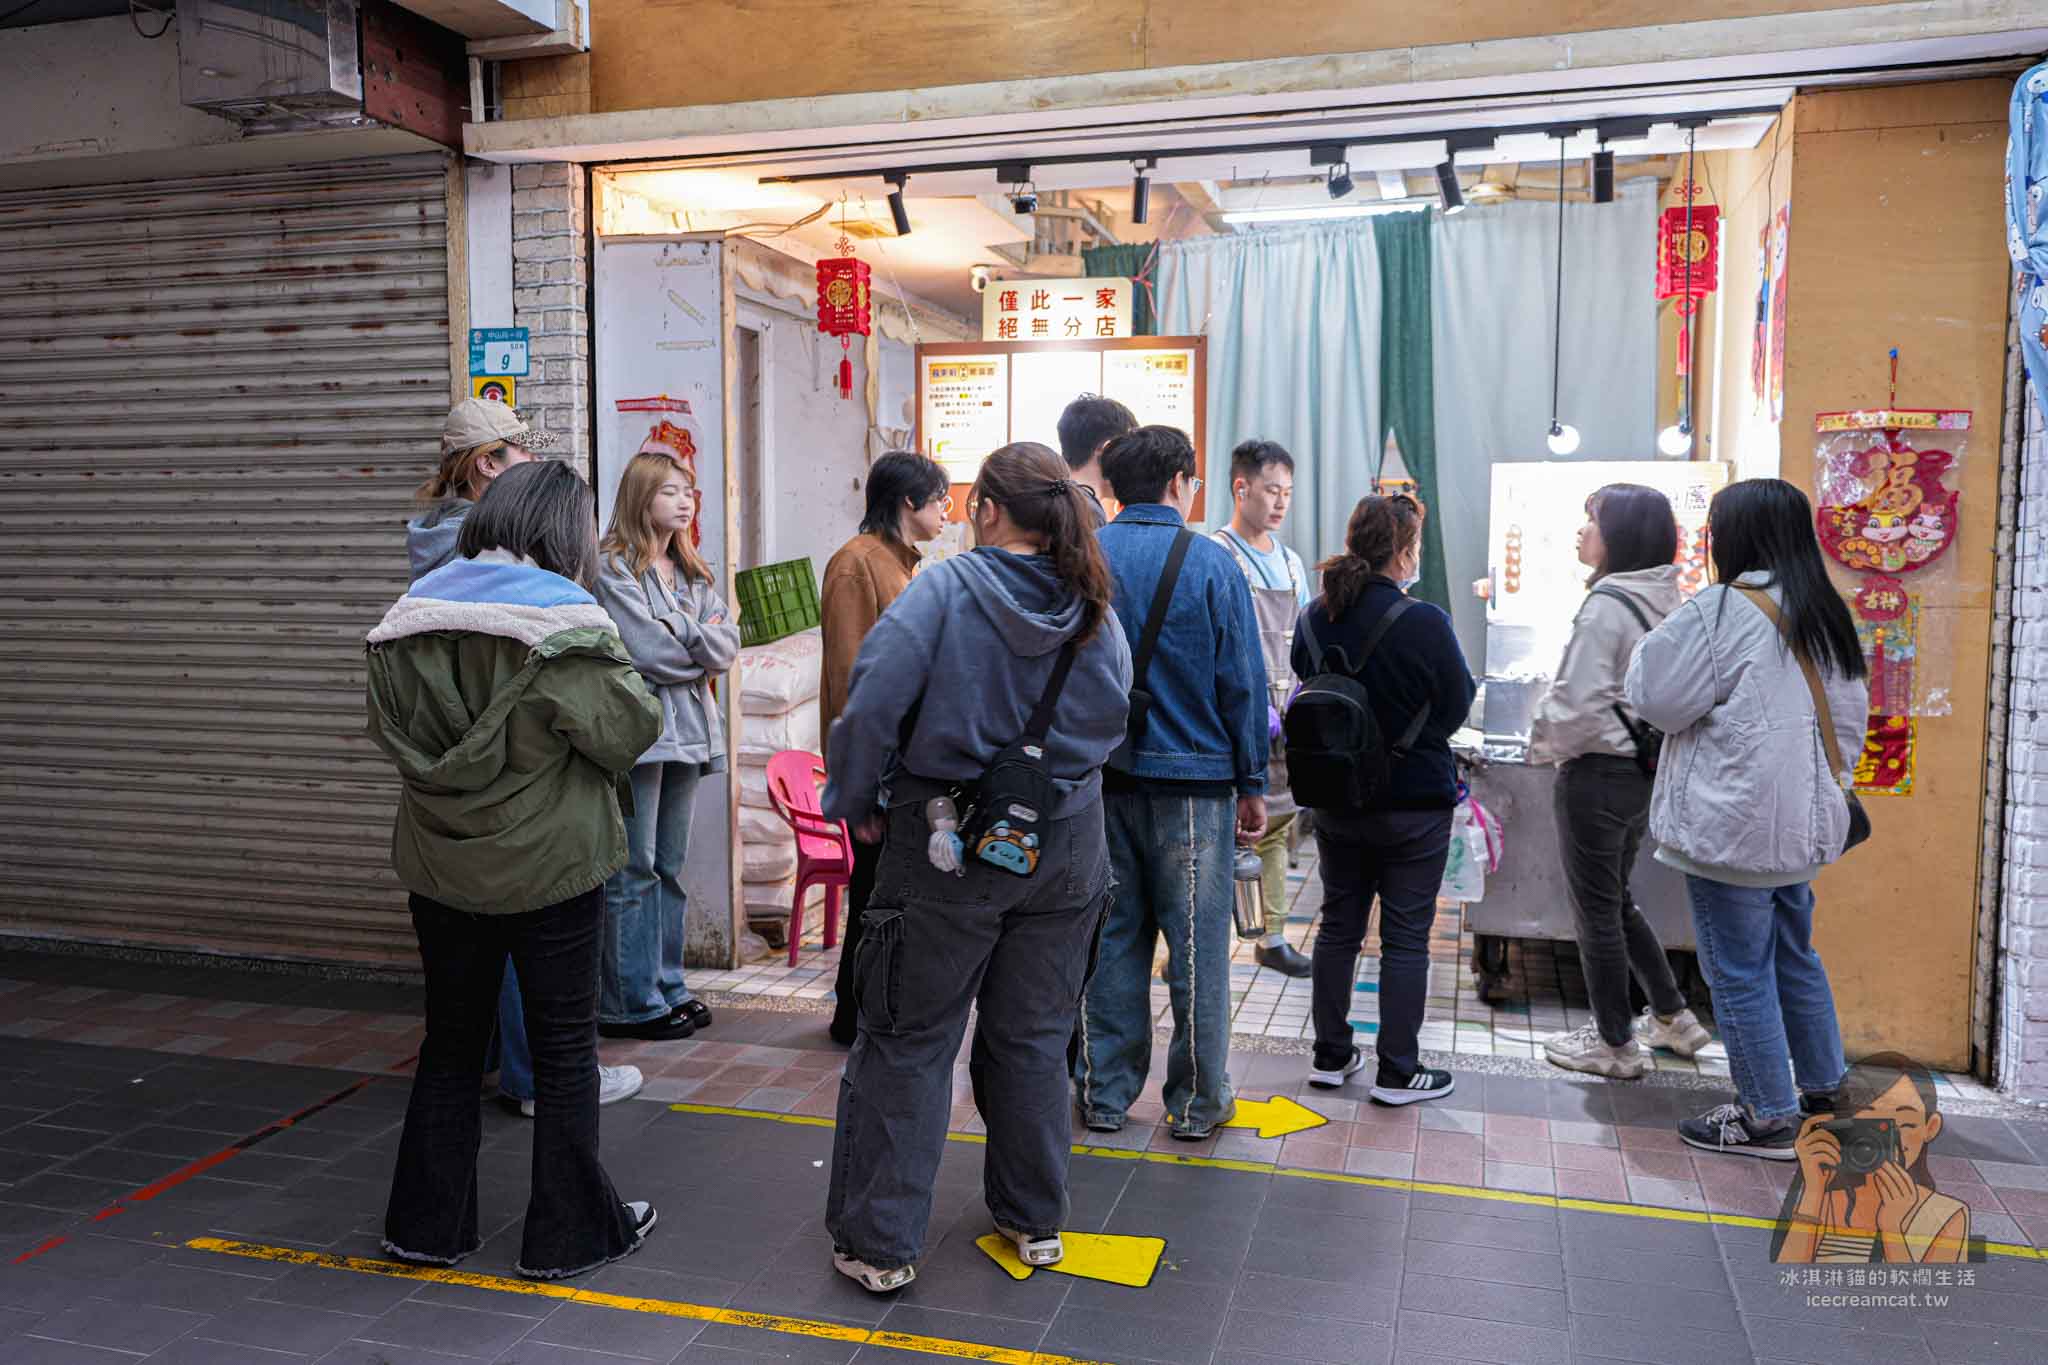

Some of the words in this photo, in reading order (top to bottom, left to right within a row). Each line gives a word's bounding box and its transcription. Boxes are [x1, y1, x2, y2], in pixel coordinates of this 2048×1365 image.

[998, 288, 1116, 311] 僅此一家
[998, 315, 1116, 339] 絕無分店
[501, 354, 511, 371] 9
